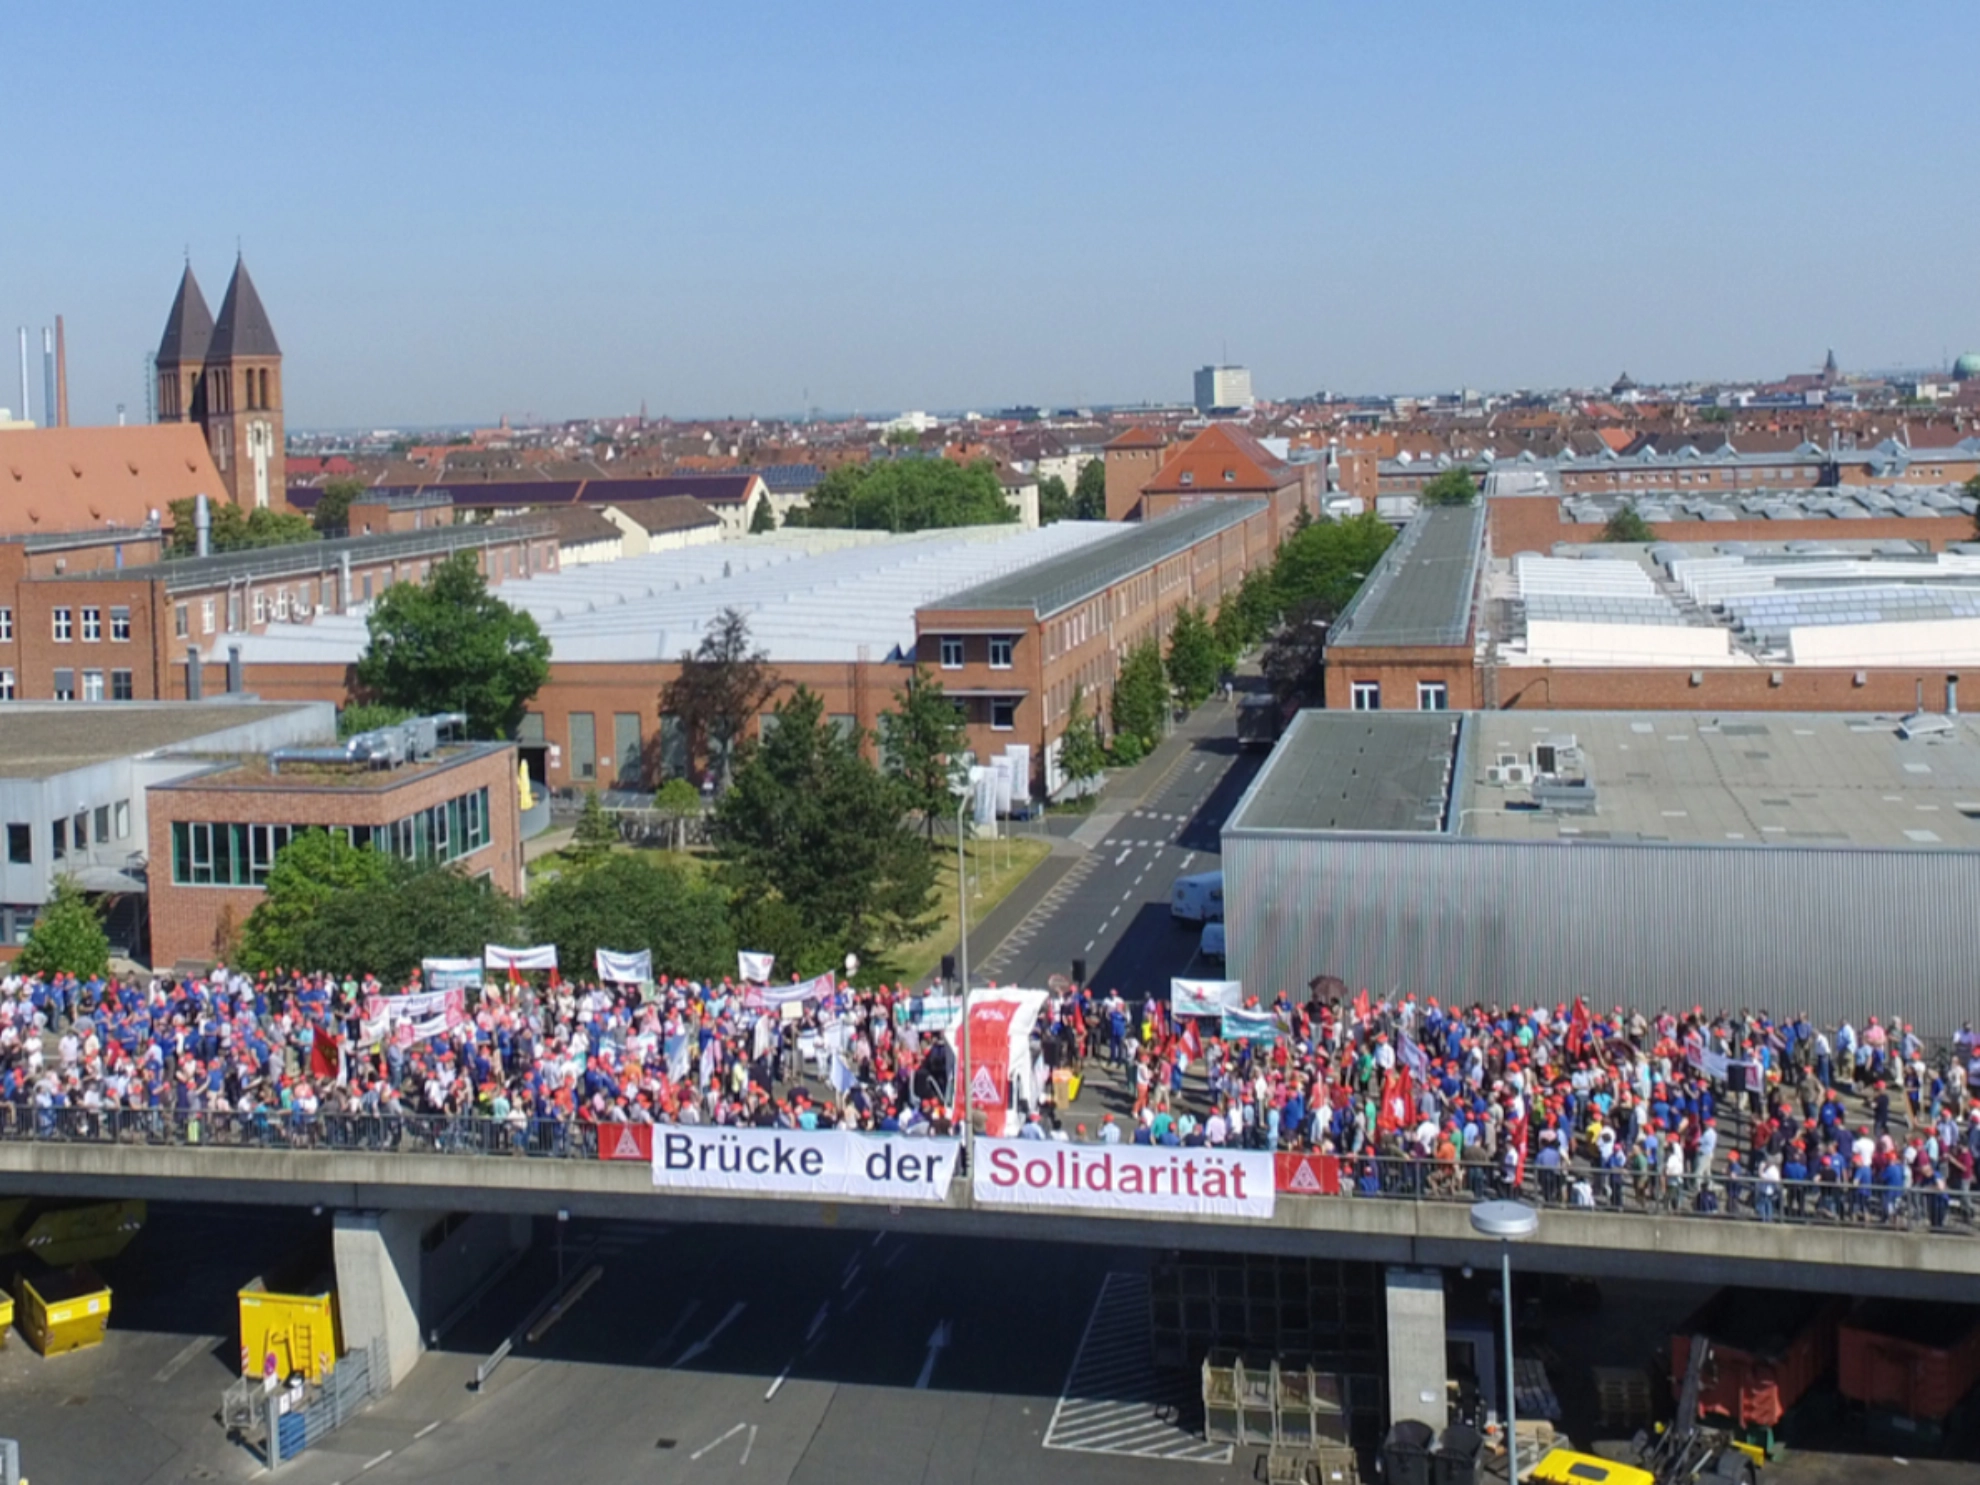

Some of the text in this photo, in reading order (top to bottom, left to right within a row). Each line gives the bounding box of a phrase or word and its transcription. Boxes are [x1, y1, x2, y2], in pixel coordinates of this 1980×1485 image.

[664, 1134, 823, 1175] Brücke
[866, 1144, 943, 1183] der
[989, 1147, 1247, 1199] Solidarität
